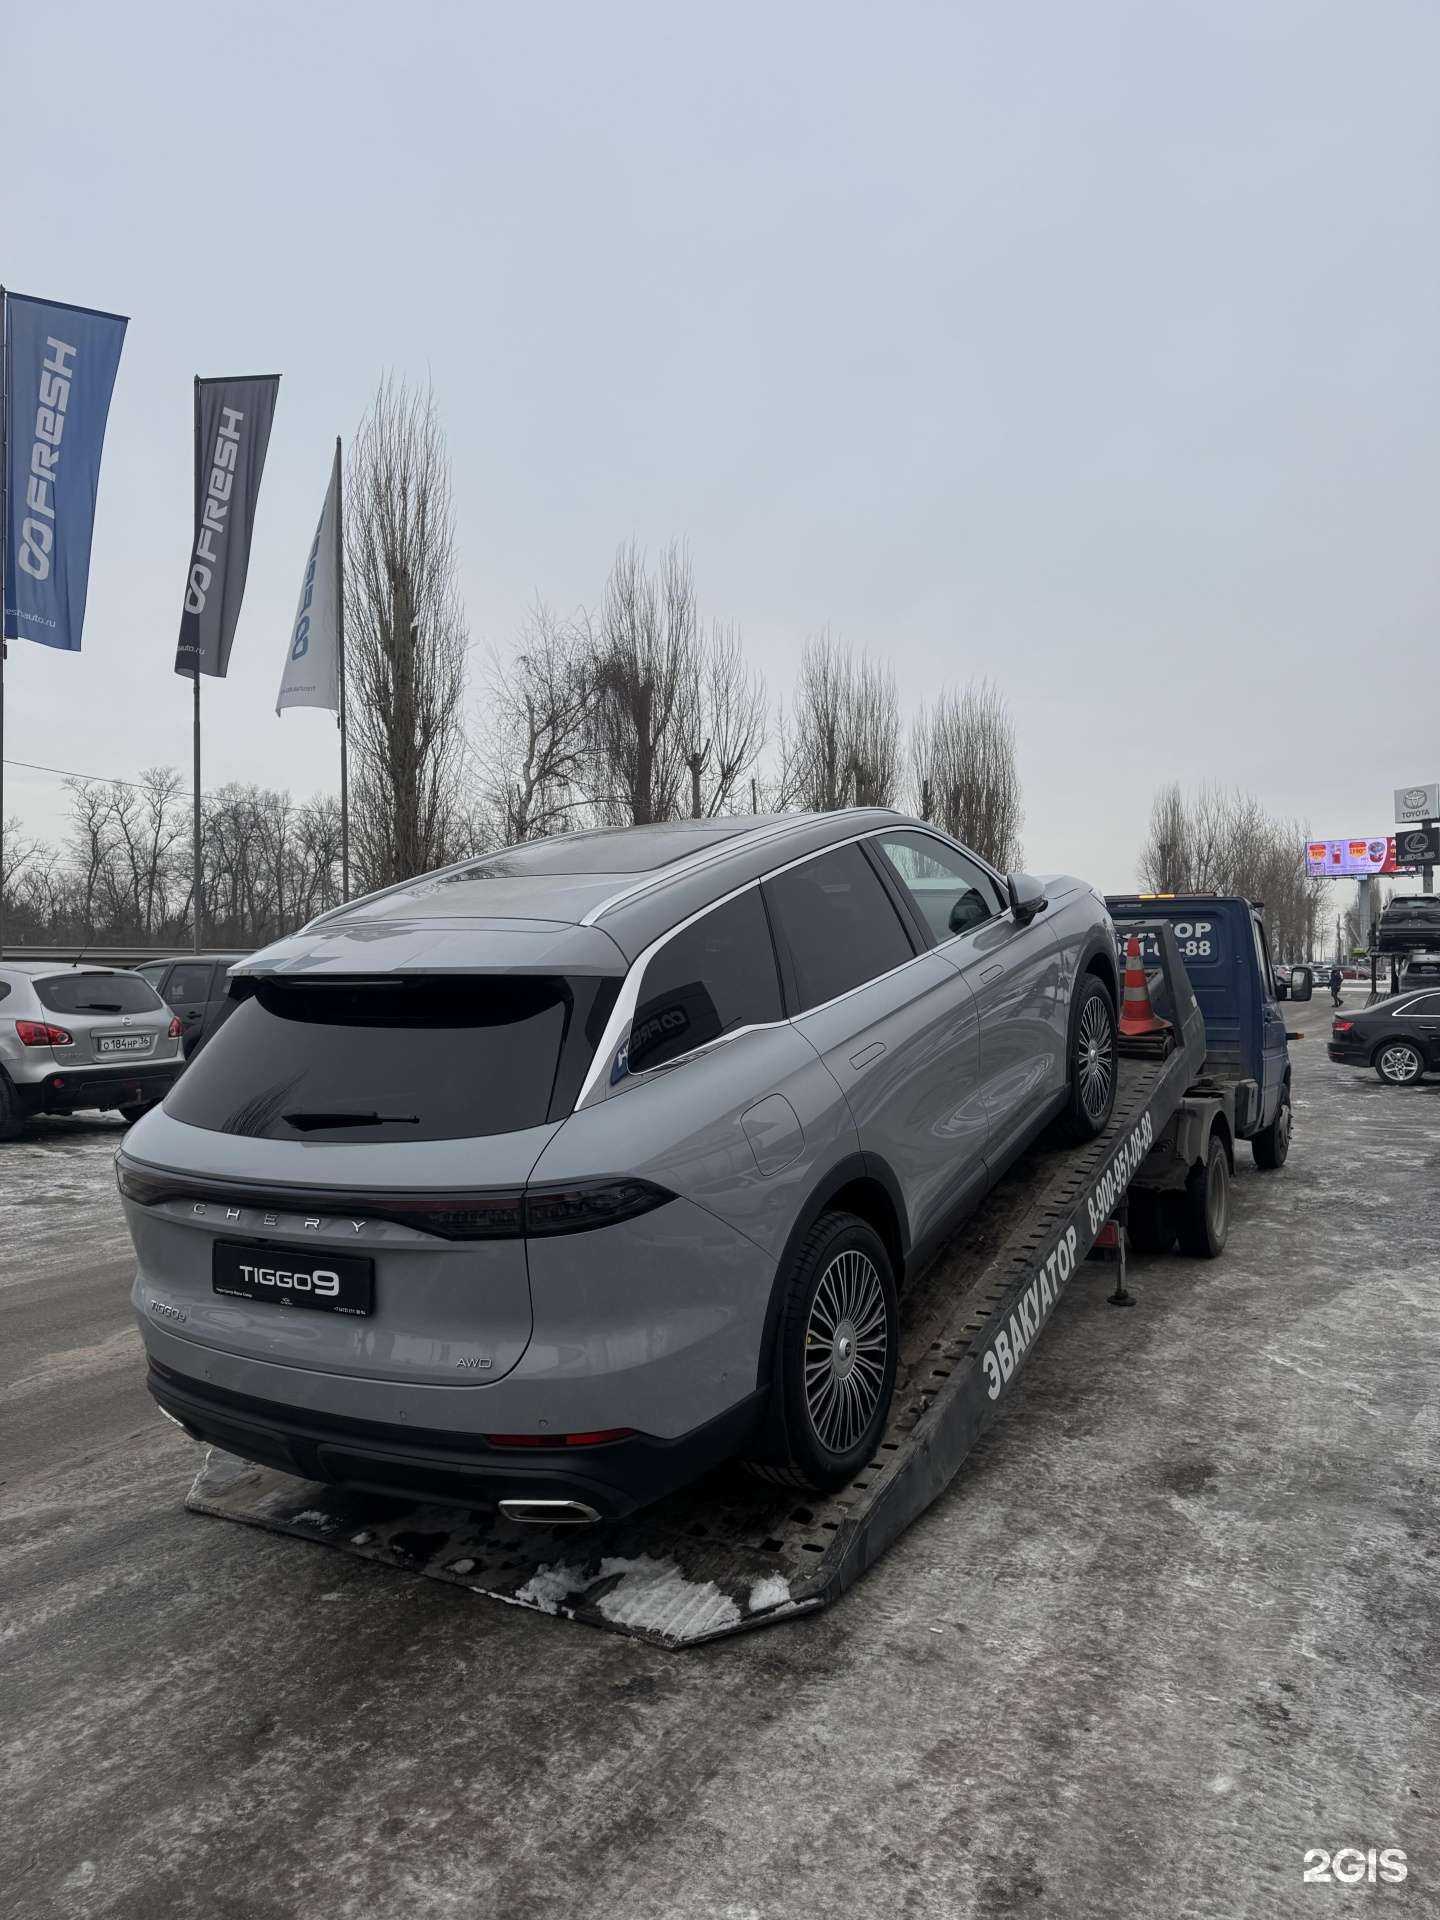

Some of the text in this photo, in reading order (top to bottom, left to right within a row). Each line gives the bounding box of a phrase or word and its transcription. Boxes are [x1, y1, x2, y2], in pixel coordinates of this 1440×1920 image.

[6, 608, 56, 628] eshauto.ru
[1402, 809, 1430, 819] TOYOTA
[193, 1203, 367, 1232] CHERY
[983, 1111, 1153, 1400] ЭВАКУАТОР 8-900-951-08-88
[456, 1358, 492, 1368] AWD
